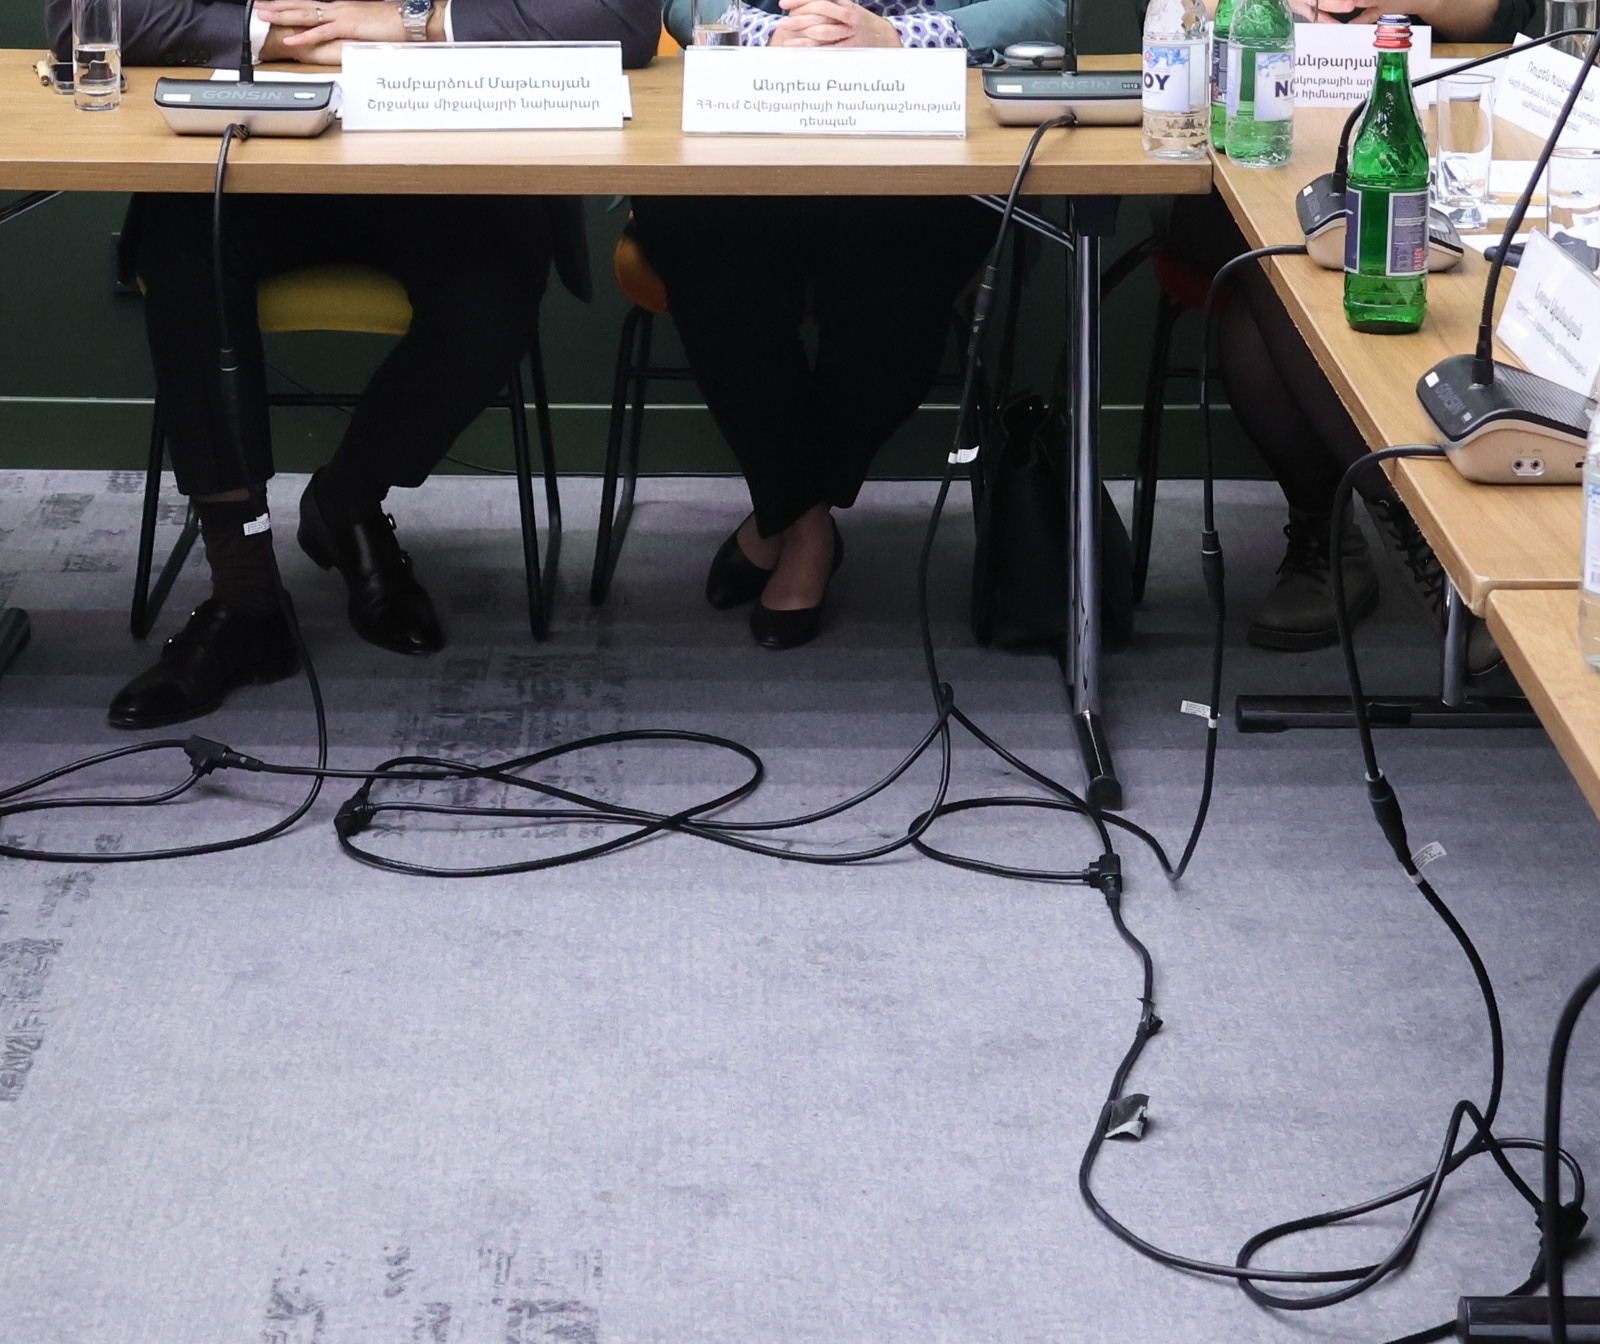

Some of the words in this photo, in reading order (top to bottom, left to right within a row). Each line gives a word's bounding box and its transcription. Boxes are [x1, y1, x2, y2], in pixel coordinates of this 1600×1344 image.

[376, 77, 484, 92] Համբարձում
[487, 77, 590, 92] Մաթևոսյան
[752, 79, 821, 94] Անդրեա
[826, 79, 906, 93] Բաուման
[1031, 81, 1111, 90] GONSIN
[201, 90, 283, 101] GONSIN
[367, 98, 429, 112] Շրջակա
[434, 98, 516, 112] միջավայրի
[521, 97, 600, 111] նախարար
[696, 100, 740, 110] ՀՀ-ում
[743, 100, 833, 114] Շվեյցարիայի
[837, 100, 961, 114] համադաշնության
[800, 116, 857, 128] դեսպան
